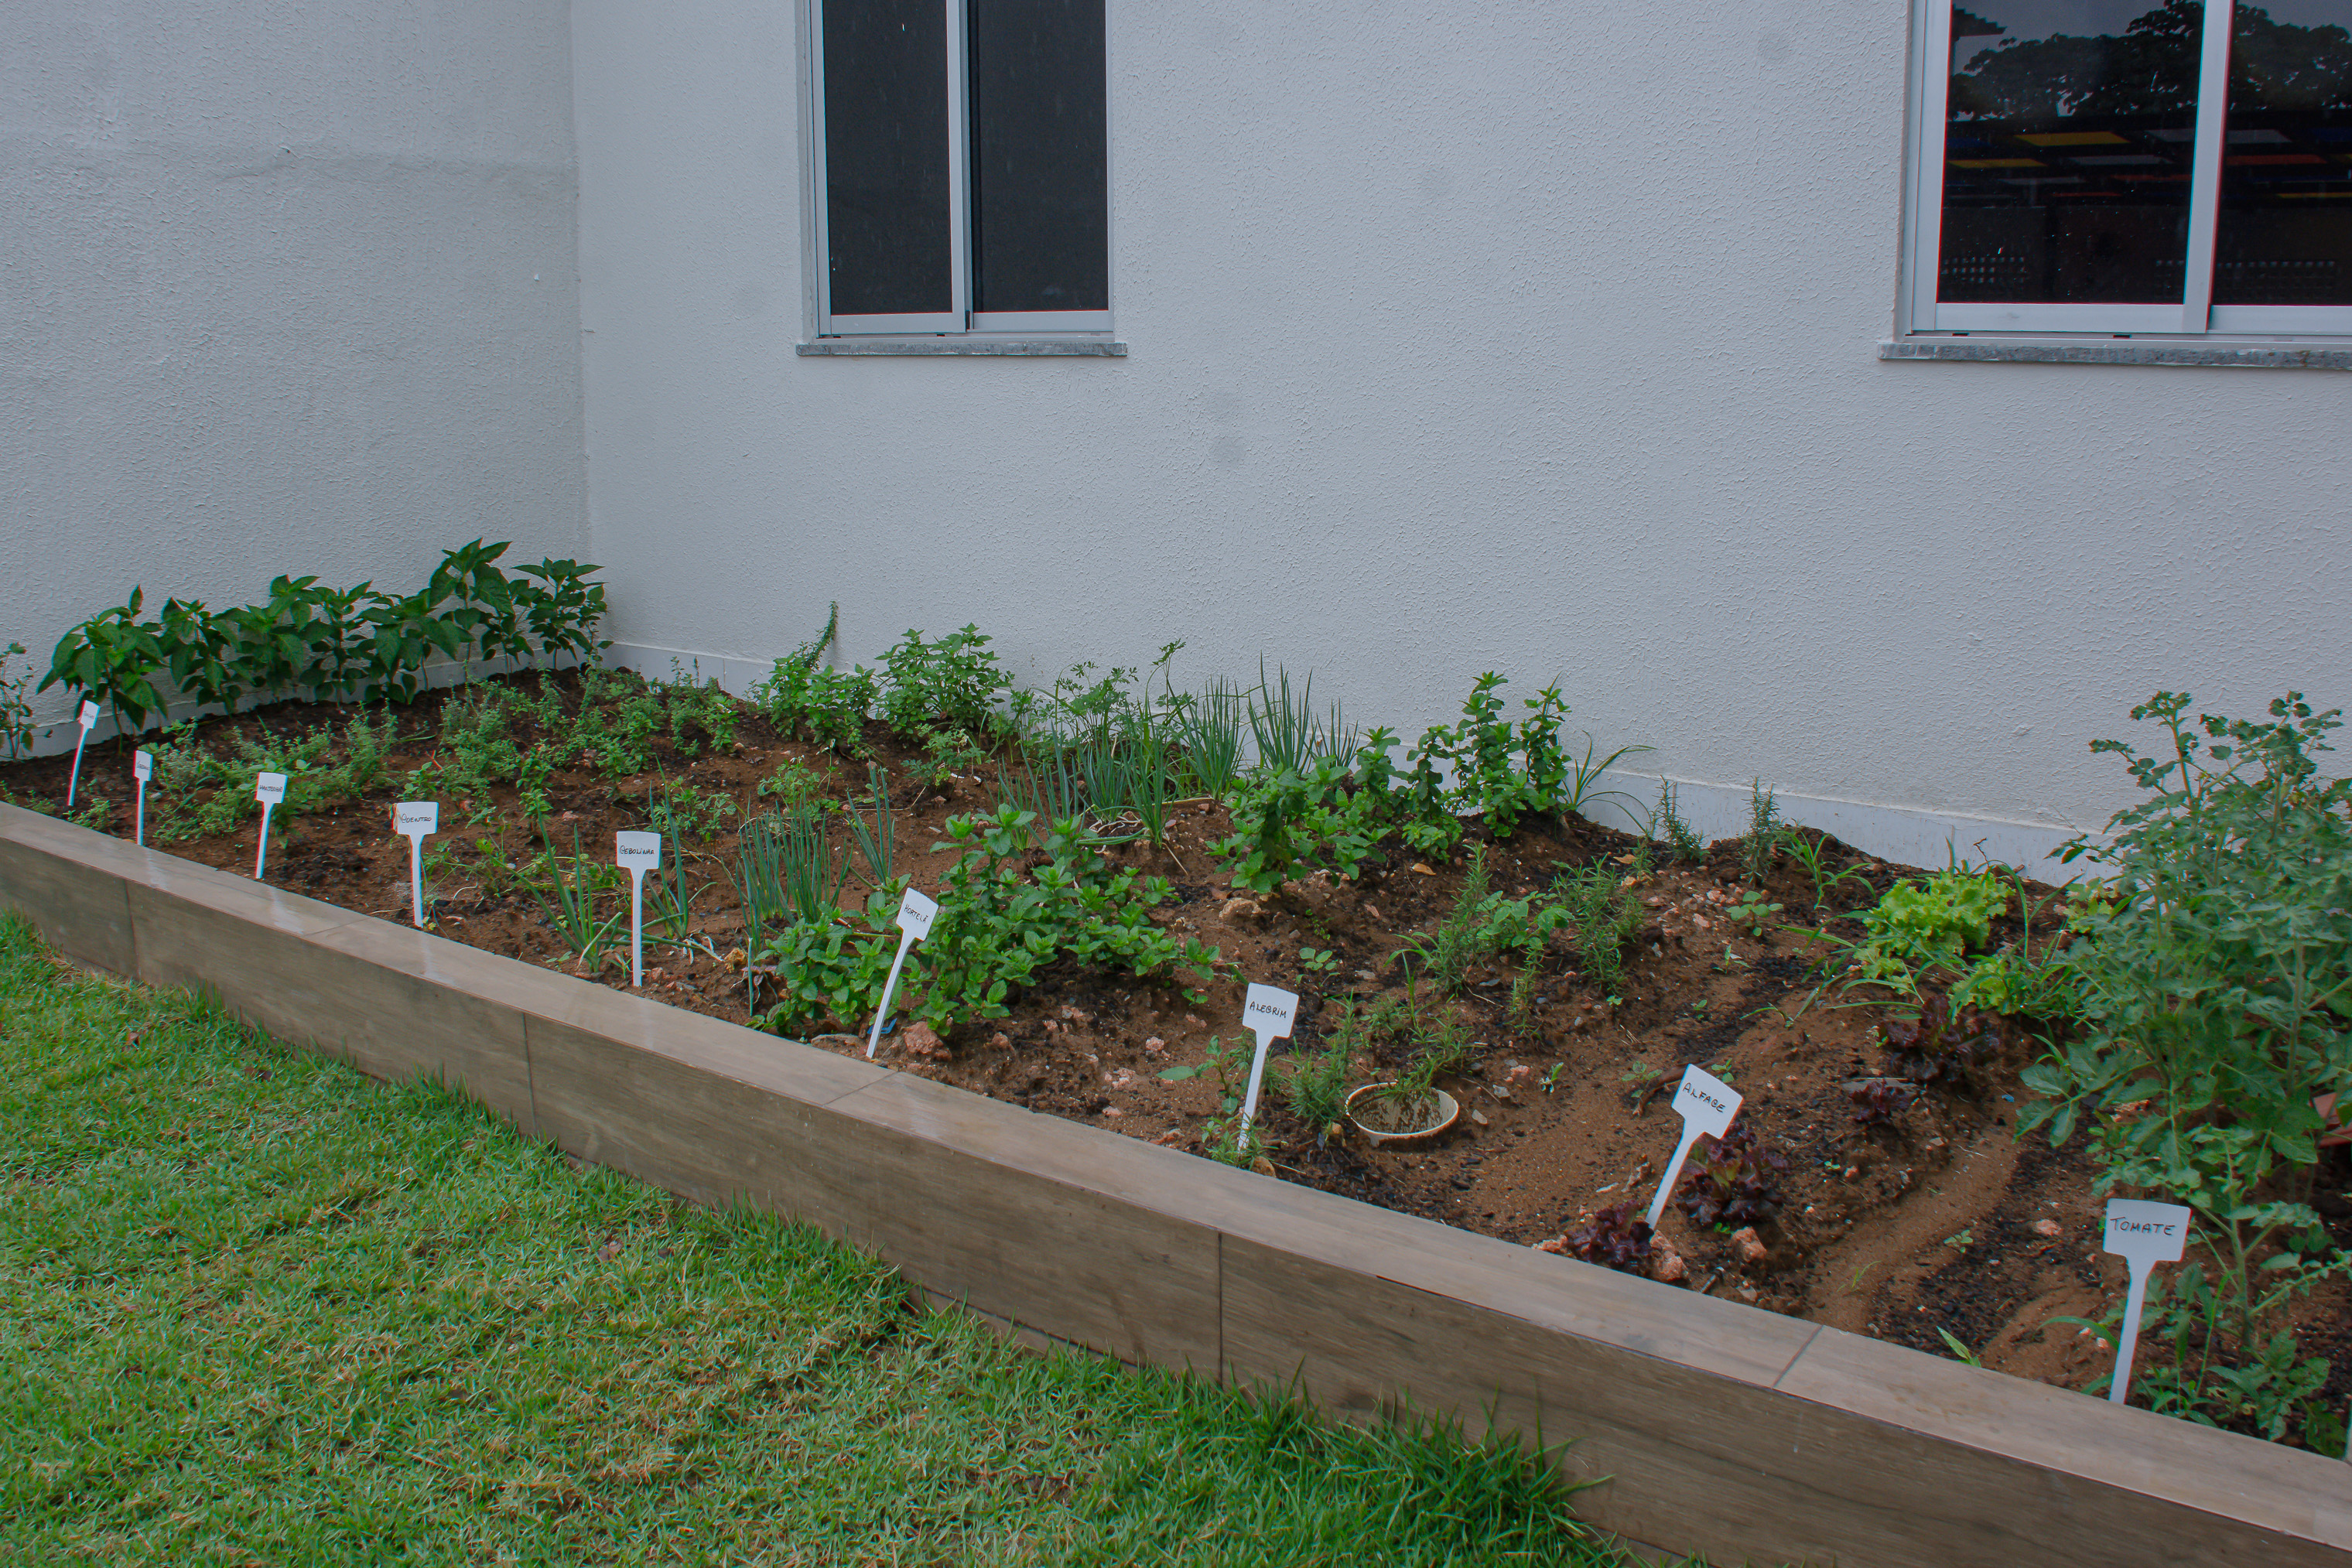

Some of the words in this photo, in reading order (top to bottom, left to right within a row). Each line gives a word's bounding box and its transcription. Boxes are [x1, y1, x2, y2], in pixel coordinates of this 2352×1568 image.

[619, 845, 655, 855] CEBOLINHA
[904, 903, 929, 924] HORTELÃ
[1682, 1081, 1726, 1113] ALFACE
[2109, 1216, 2177, 1236] TOMATE
